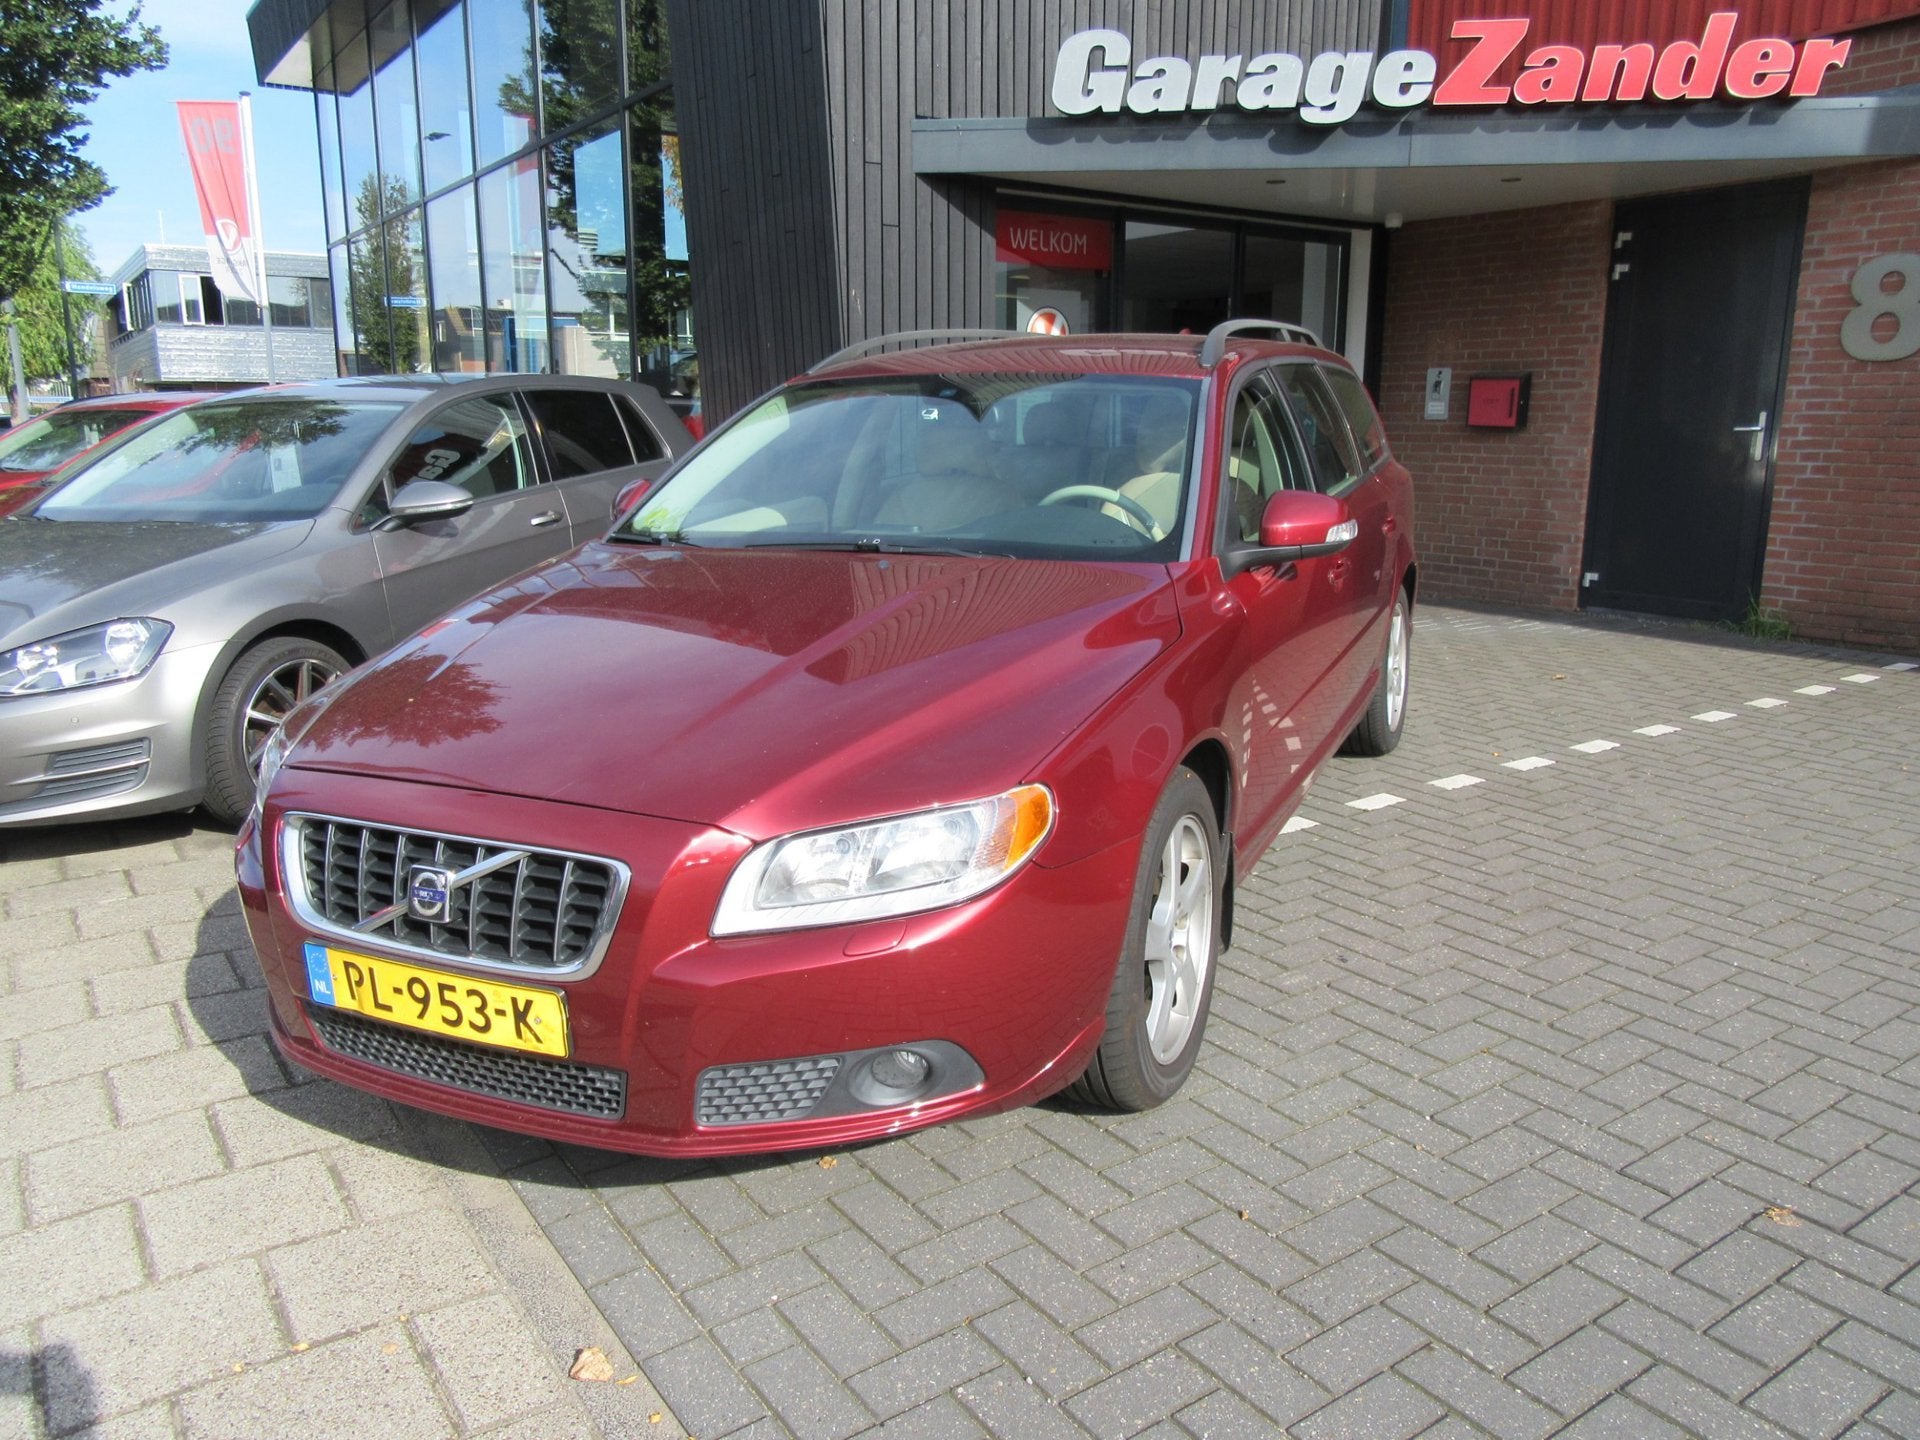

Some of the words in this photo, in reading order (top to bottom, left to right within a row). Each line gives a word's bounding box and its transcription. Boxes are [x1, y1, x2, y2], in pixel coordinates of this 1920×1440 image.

[1009, 226, 1088, 256] WELKOM
[1840, 253, 1920, 362] 8
[314, 978, 332, 996] NL
[342, 960, 544, 1045] PL-953-K
